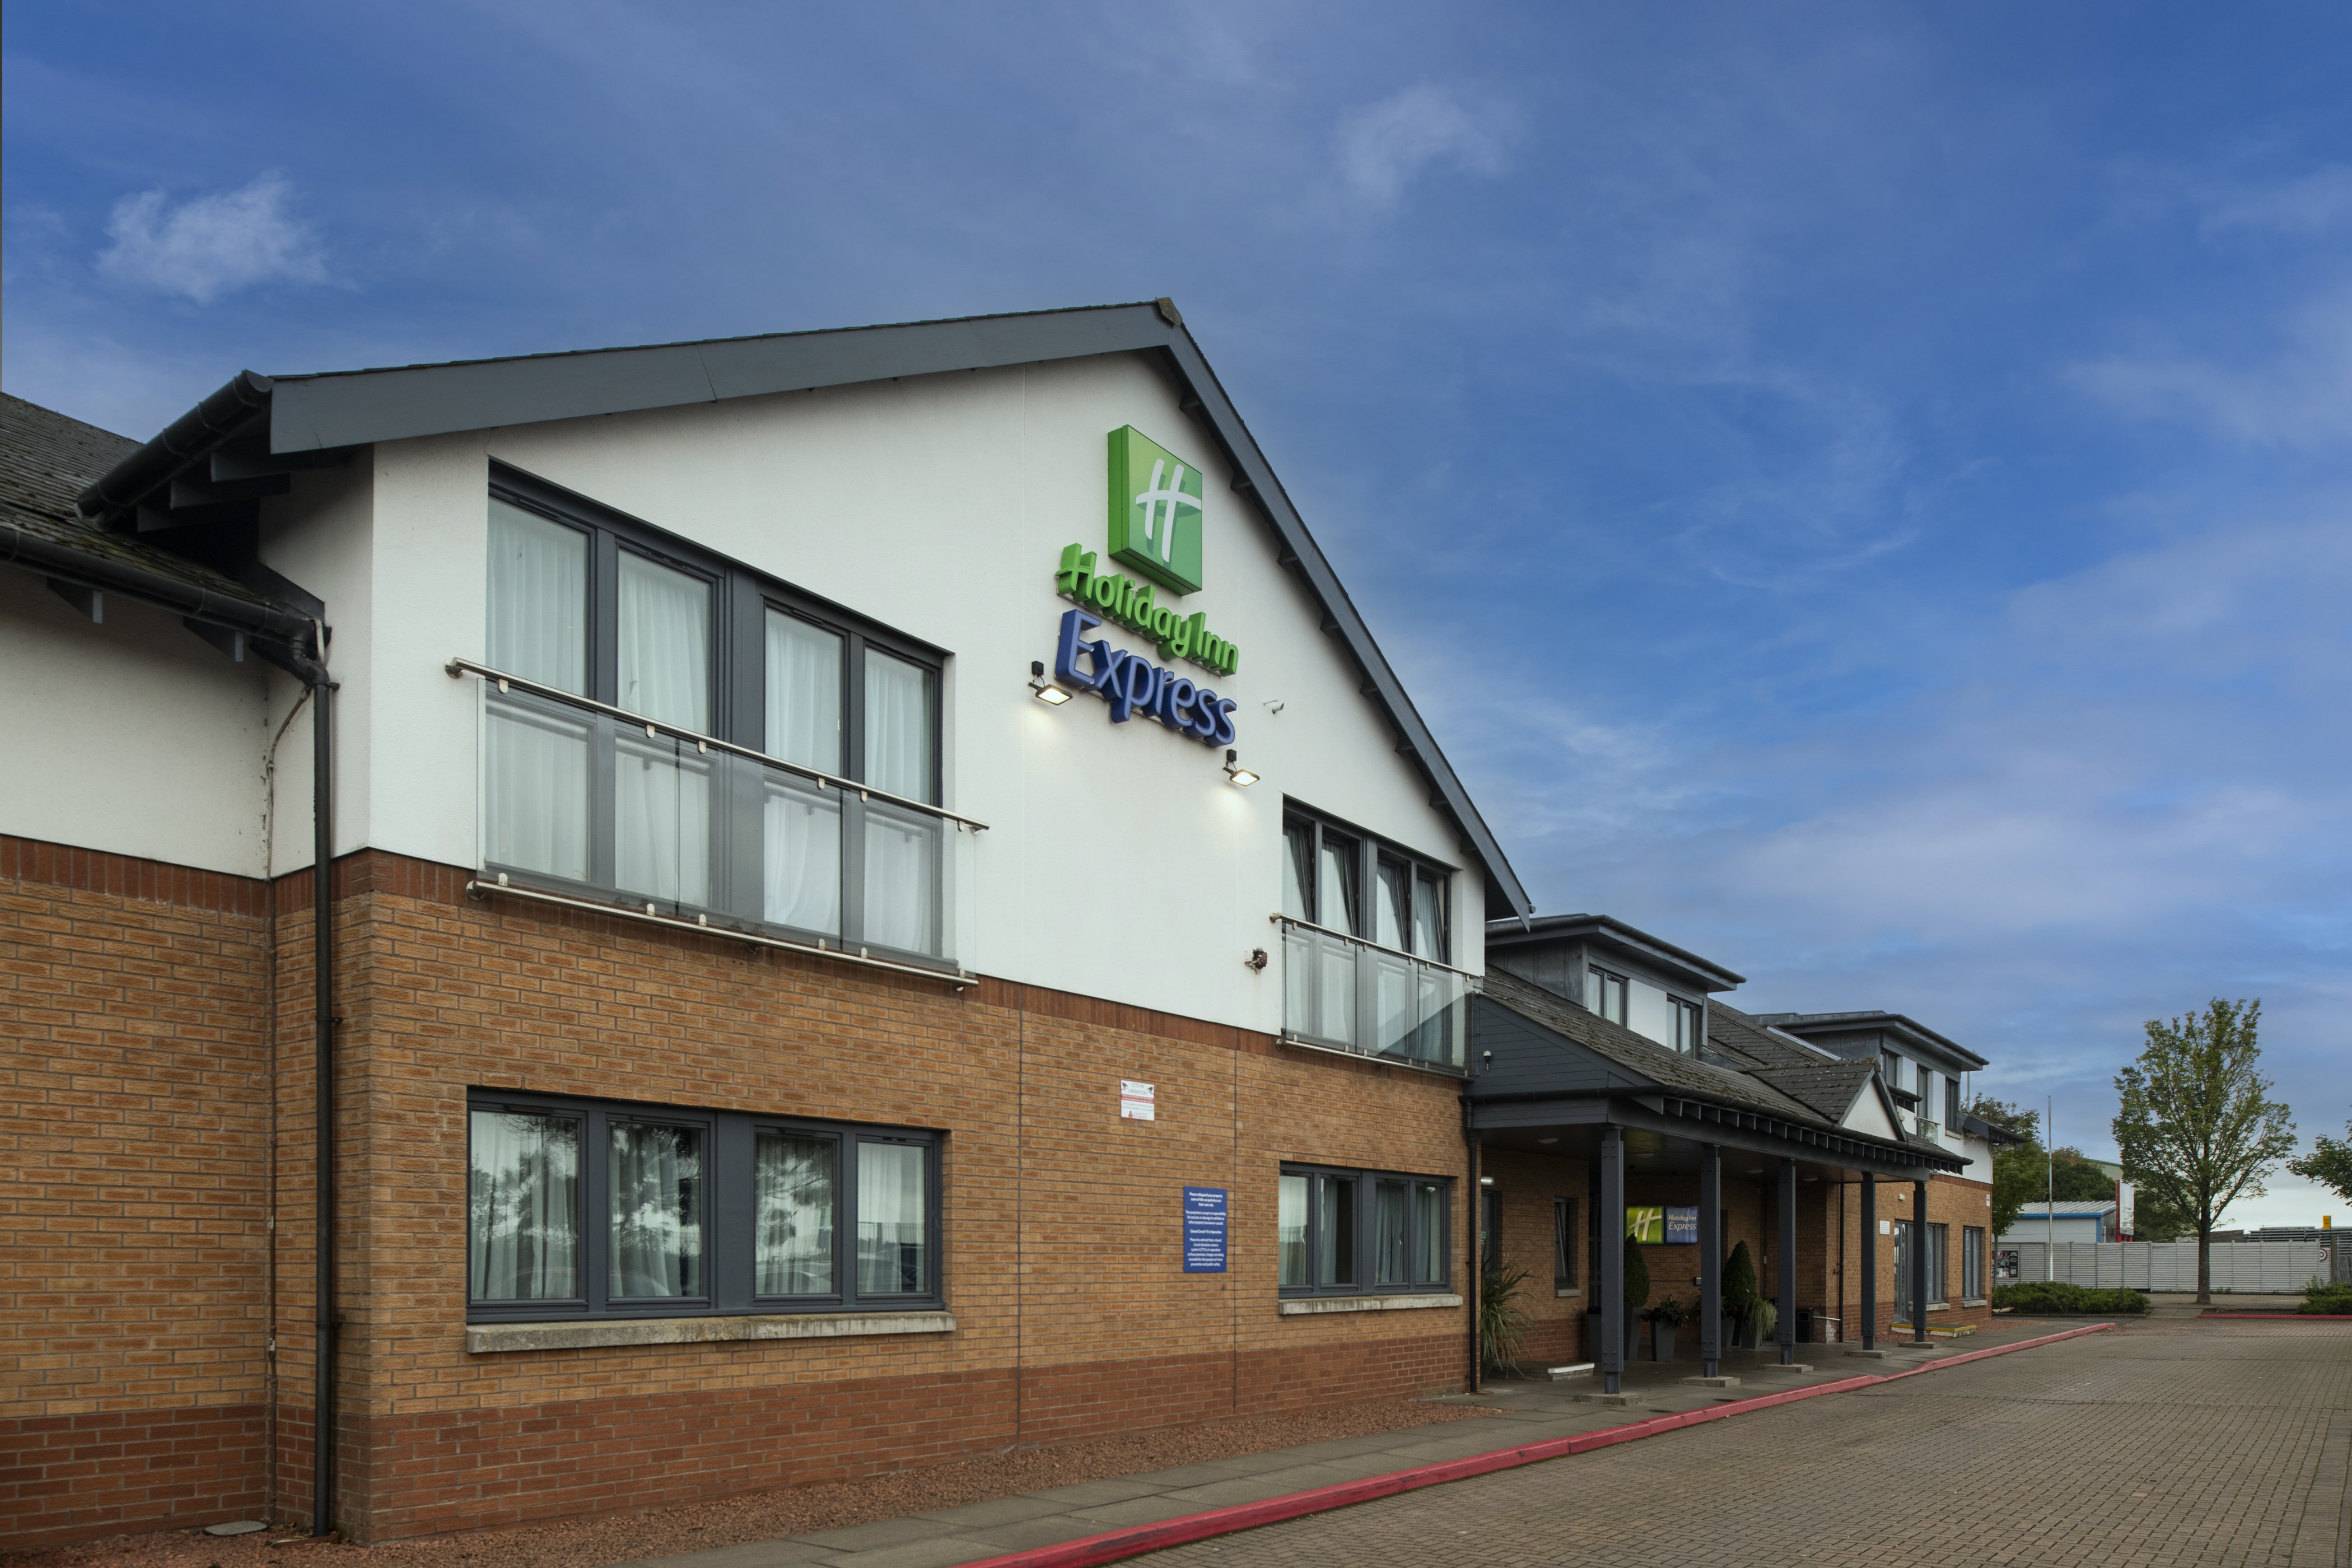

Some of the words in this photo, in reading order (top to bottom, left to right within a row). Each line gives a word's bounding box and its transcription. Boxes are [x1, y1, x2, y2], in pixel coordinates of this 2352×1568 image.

[1056, 543, 1193, 661] Holiday
[1186, 612, 1238, 676] Inn
[1055, 609, 1237, 748] Express
[1668, 1222, 1696, 1231] Express
